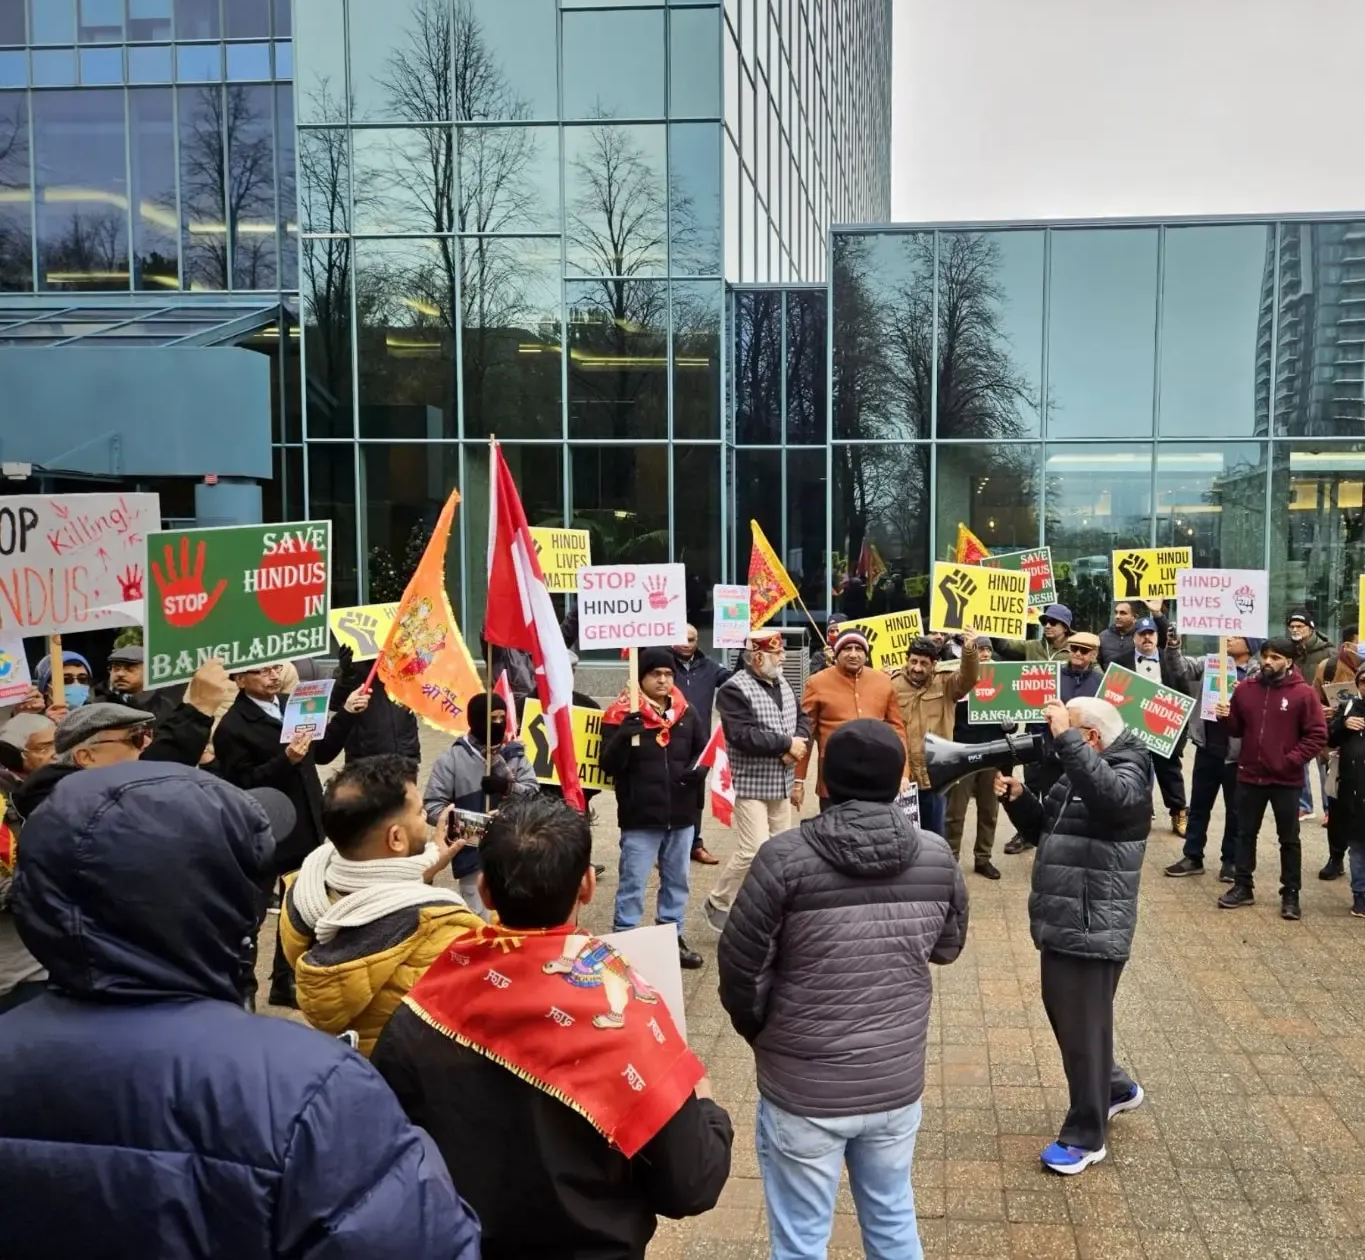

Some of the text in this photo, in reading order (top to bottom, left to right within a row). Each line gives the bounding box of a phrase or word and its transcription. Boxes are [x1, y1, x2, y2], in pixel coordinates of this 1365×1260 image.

[263, 528, 326, 556] SAVE
[551, 534, 586, 550] HINDU
[556, 553, 587, 569] LIVES
[1020, 550, 1048, 562] SAVE
[1157, 551, 1189, 565] HINDU
[244, 562, 326, 593] HINDUS
[583, 572, 635, 590] STOP
[988, 574, 1026, 593] HINDU
[1042, 579, 1052, 588] IN
[1182, 576, 1231, 588] HINDU
[0, 566, 88, 628] NDUS
[1148, 584, 1176, 596] MATT
[164, 593, 208, 615] STOP
[304, 595, 325, 618] IN
[584, 600, 642, 615] HINDU
[990, 594, 1024, 614] LIVES
[1182, 596, 1221, 608] LIVES
[585, 622, 676, 640] GENOCIDE
[885, 614, 919, 633] HINDU
[973, 614, 1022, 635] MATTER
[1182, 616, 1242, 630] MATTER
[152, 627, 325, 680] BANGLADESH
[1021, 663, 1056, 676] SAVE
[975, 687, 995, 697] STOP
[1012, 680, 1056, 691] HINDUS
[1104, 689, 1124, 704] STOP
[1155, 689, 1191, 712] SAVE
[970, 709, 1047, 721] BANGLADES
[1140, 698, 1184, 724] HINDUS
[1163, 726, 1177, 737] IN
